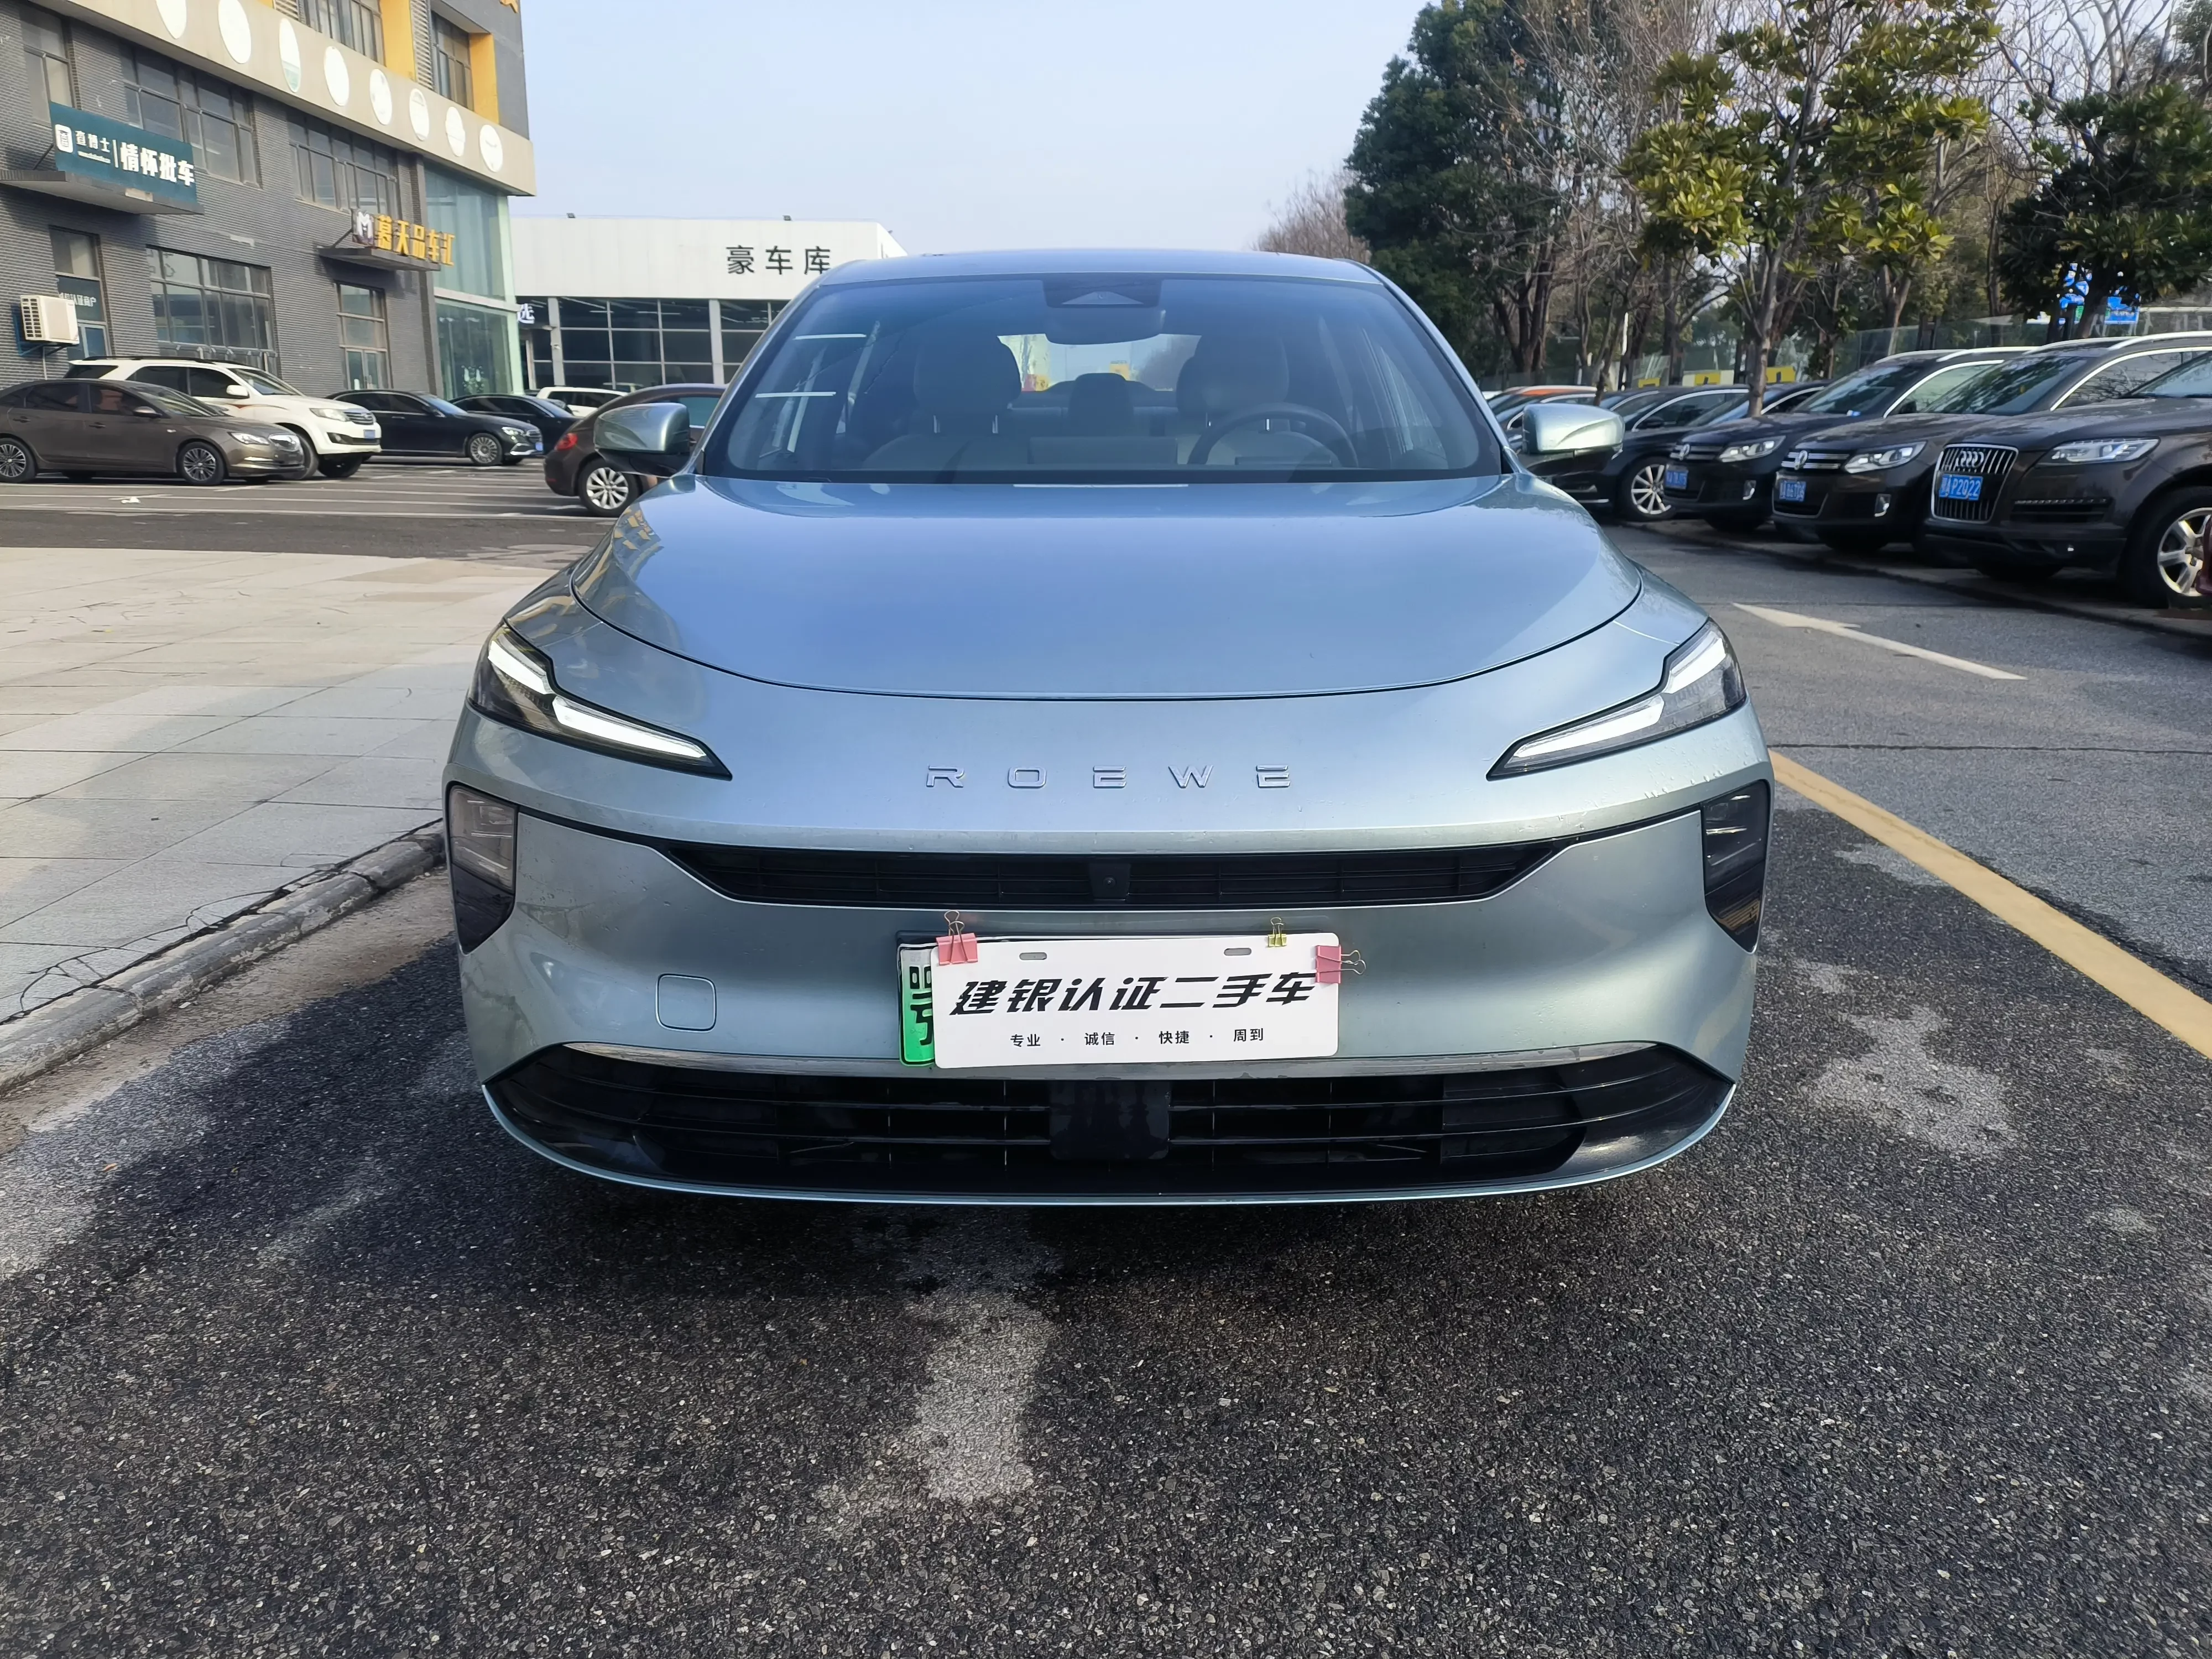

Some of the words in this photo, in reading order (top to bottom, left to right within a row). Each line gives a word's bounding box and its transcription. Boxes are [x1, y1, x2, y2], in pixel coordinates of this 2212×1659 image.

[120, 142, 195, 186] 情怀批车
[726, 244, 831, 275] 豪车库
[926, 765, 1291, 788] ROEWE
[950, 971, 1317, 1015] 建银认证二手车
[1010, 1033, 1041, 1047] 专业
[1084, 1032, 1115, 1046] 诚信
[1159, 1030, 1190, 1044] 快捷
[1233, 1027, 1264, 1042] 周到
